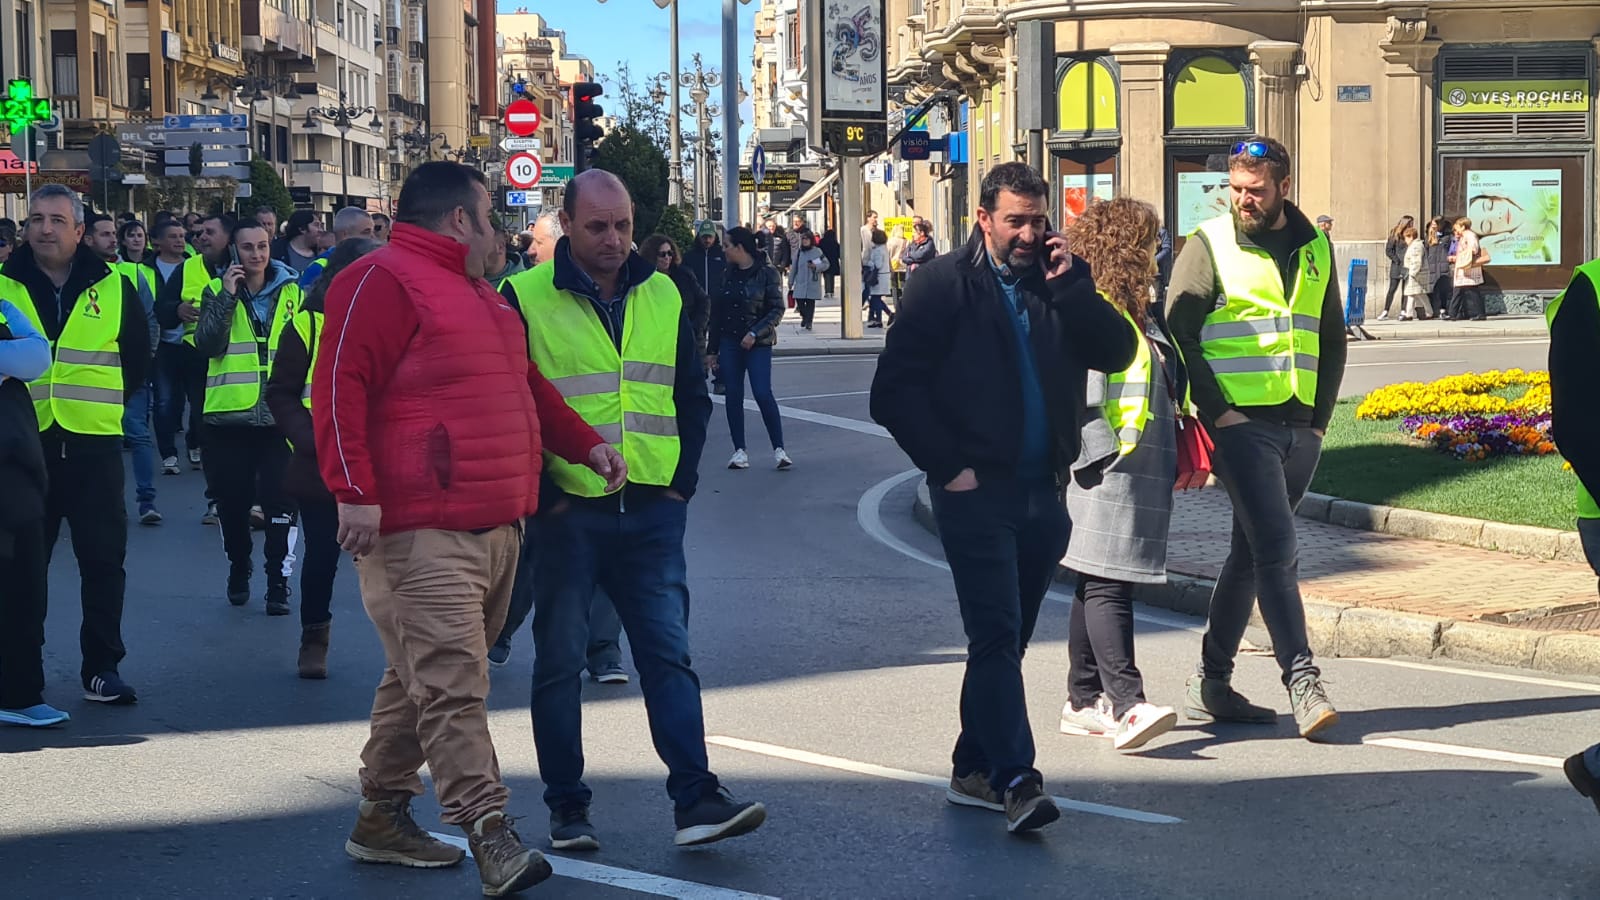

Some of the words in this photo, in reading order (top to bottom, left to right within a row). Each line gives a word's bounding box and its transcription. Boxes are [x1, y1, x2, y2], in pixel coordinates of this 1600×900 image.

[859, 73, 877, 86] AÑOS
[1471, 91, 1511, 103] YVES
[1516, 90, 1584, 102] ROCHER
[121, 132, 142, 141] DEL
[516, 164, 532, 177] 10
